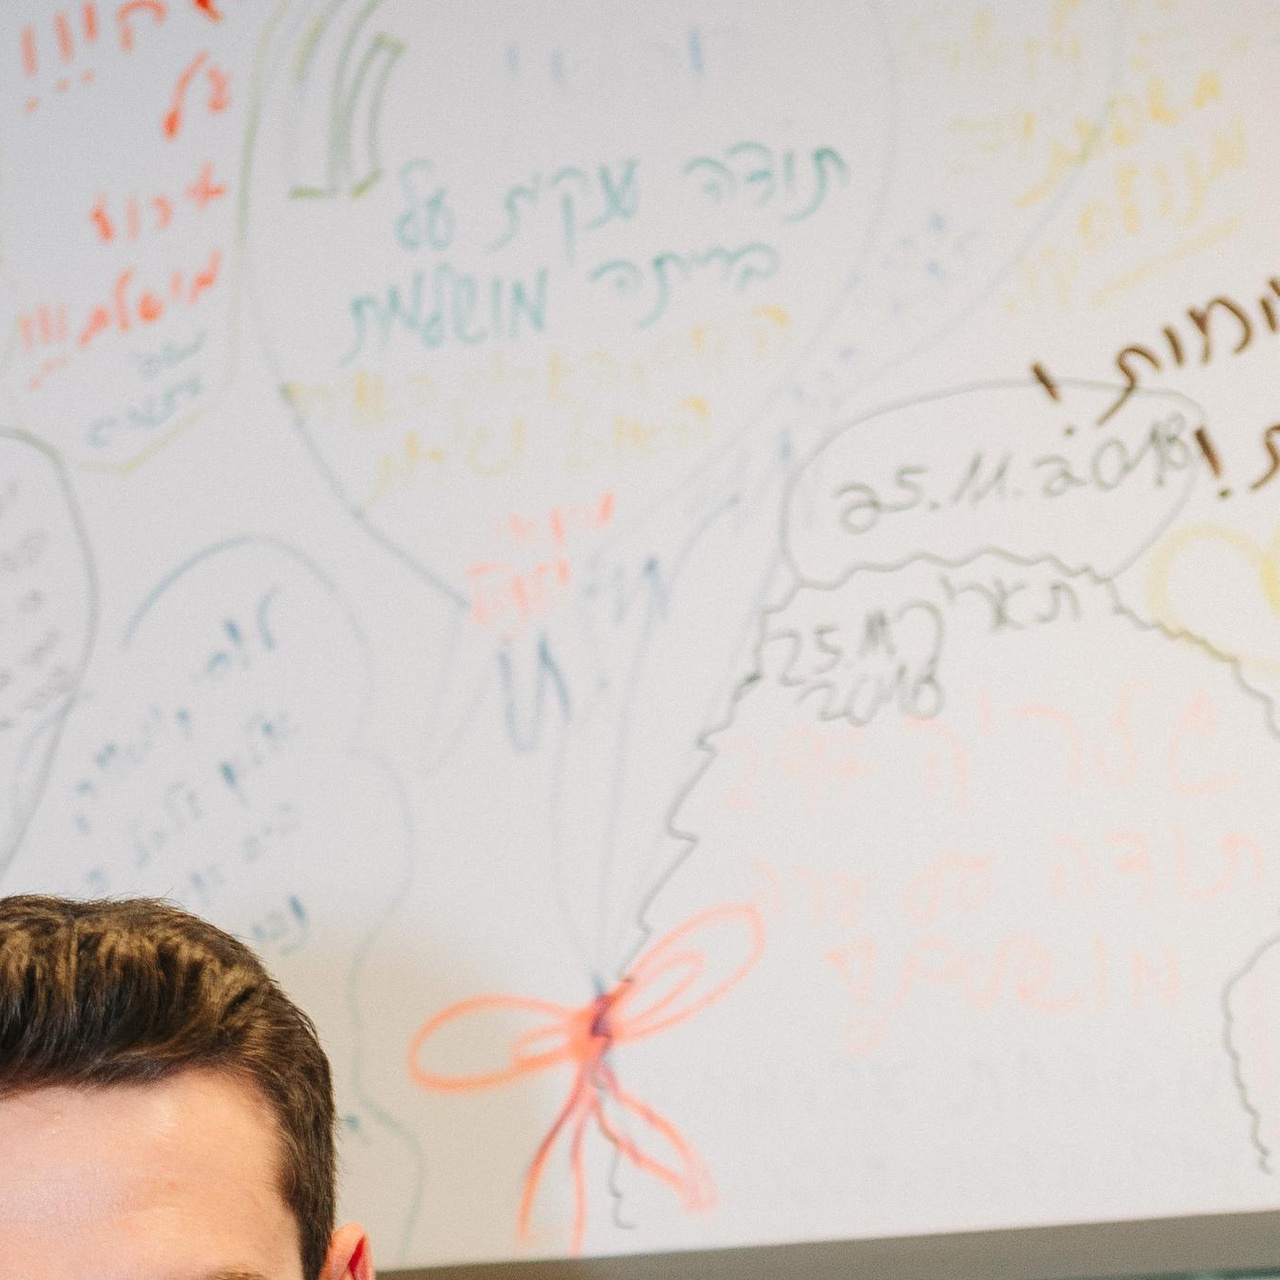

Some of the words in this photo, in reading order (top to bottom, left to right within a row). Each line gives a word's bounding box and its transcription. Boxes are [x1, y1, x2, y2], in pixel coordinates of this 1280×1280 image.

[394, 156, 456, 252] על
[683, 140, 850, 224] תודה
[336, 262, 550, 368] מושלמת
[833, 411, 1194, 535] 25.11.2018
